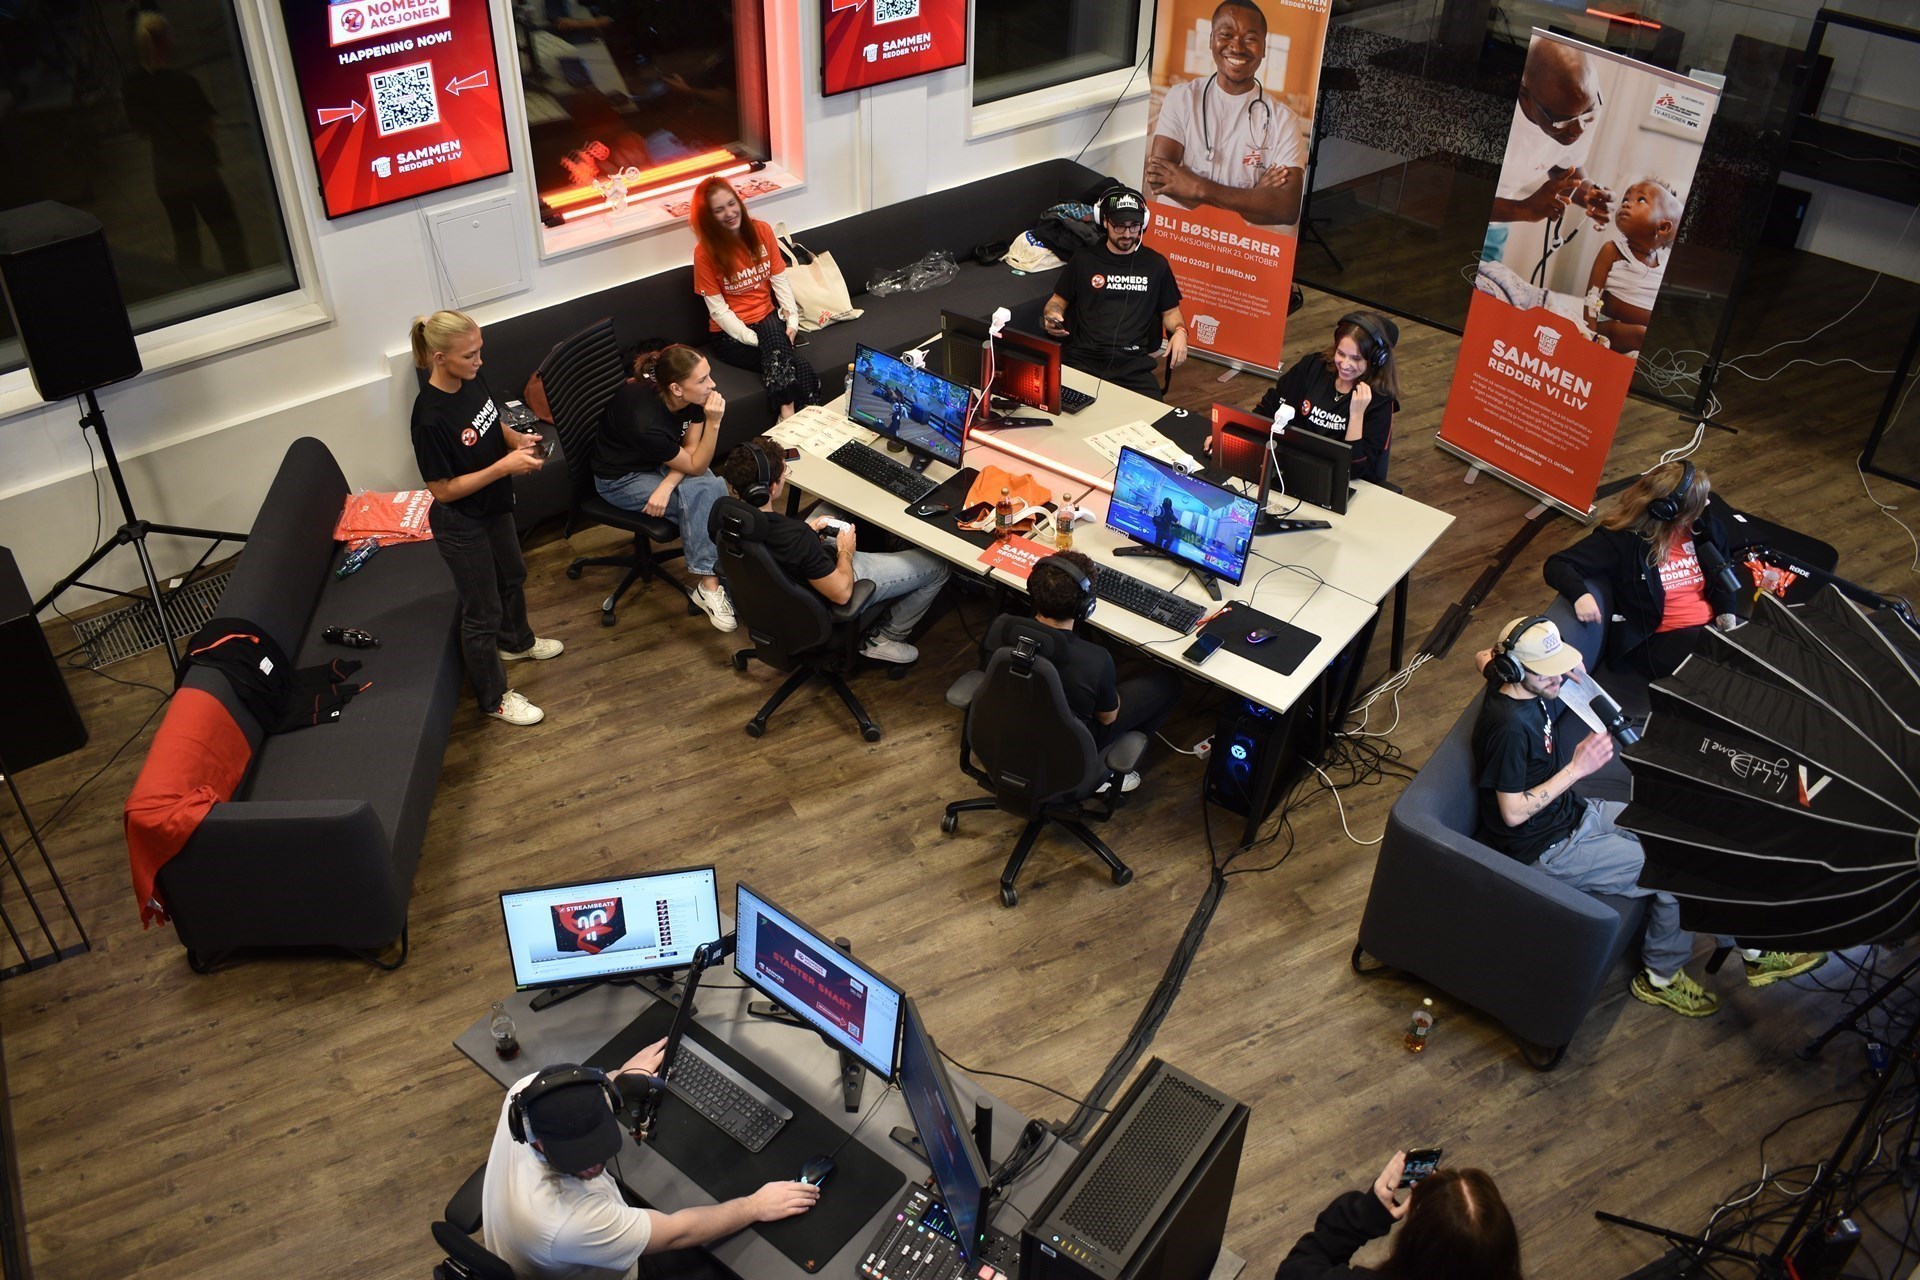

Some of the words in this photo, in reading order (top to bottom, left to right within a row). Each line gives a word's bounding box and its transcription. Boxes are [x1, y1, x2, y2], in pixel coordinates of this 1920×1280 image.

[368, 0, 437, 16] NOMED
[370, 6, 440, 29] AKSJONEN
[338, 40, 414, 64] HAPPENING
[417, 30, 452, 48] NOW!
[882, 32, 931, 52] SAMMEN
[882, 48, 910, 60] REDDER
[920, 43, 931, 51] LIV
[396, 140, 460, 164] SAMMEN
[398, 159, 434, 173] REDDER
[448, 151, 462, 161] LIV
[1155, 214, 1177, 230] BLI
[1181, 222, 1281, 258] BØSSEBÆRER
[1154, 229, 1168, 239] FOR
[1169, 233, 1216, 251] TV-AKSJONEN
[1216, 245, 1233, 255] NRK
[1234, 249, 1243, 258] 23.
[1244, 252, 1278, 268] OKTOBER
[724, 260, 771, 285] SMMEN
[1107, 275, 1148, 284] NOMEDS
[1170, 253, 1188, 264] RING
[1189, 258, 1210, 270] 02025
[1216, 265, 1257, 282] BLIMED.NO
[1106, 283, 1148, 291] AKSJONEN
[1492, 339, 1592, 398] SAMMEN
[1488, 357, 1540, 391] REDDER
[1546, 384, 1560, 399] VI
[1563, 392, 1588, 410] LIV
[472, 396, 494, 430] NOMED
[479, 407, 498, 437] AKSJON
[400, 490, 424, 527] SAMMEN
[997, 549, 1027, 564] REDDER
[1001, 544, 1042, 562] SAMM
[1660, 570, 1690, 582] EDDER
[566, 901, 615, 912] STREAMBEATS
[772, 952, 815, 986] STARTER
[818, 982, 853, 1011] SNART
